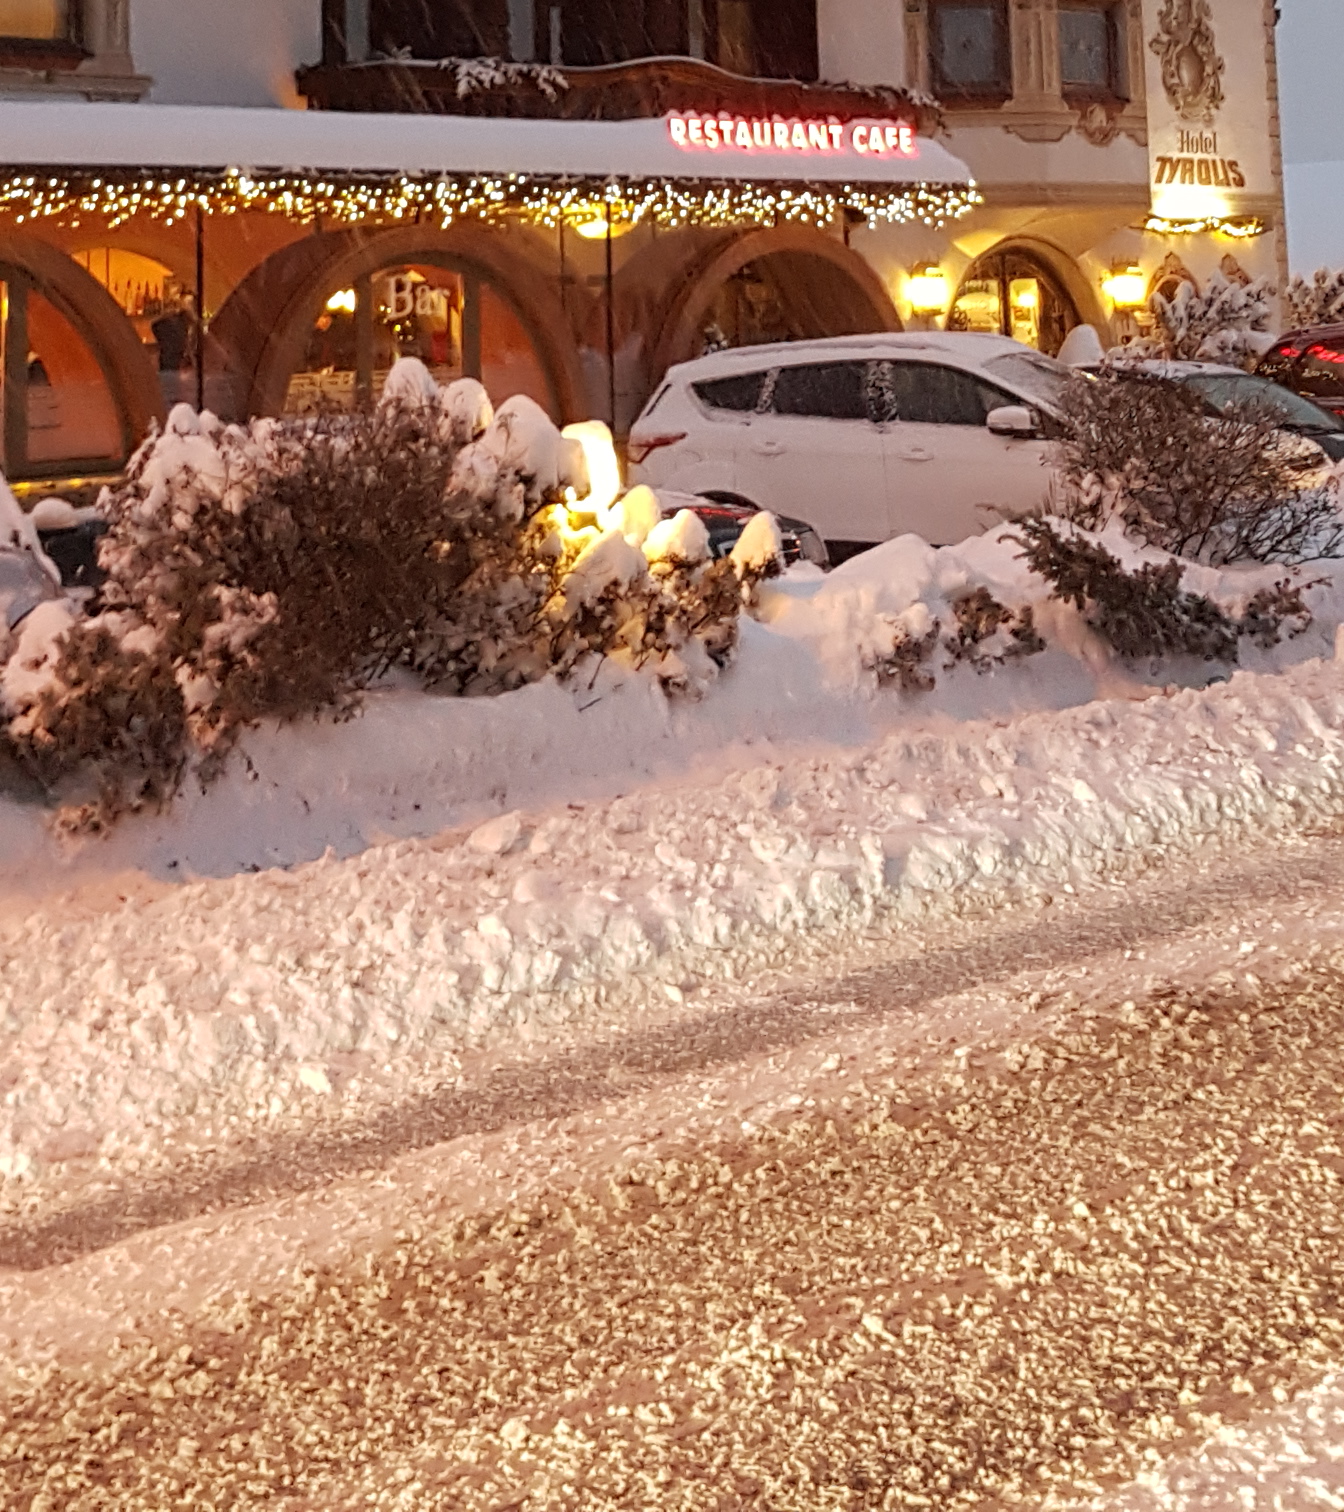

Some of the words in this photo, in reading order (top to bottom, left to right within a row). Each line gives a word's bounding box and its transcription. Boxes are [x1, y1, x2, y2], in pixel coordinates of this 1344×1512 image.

[669, 117, 843, 150] RESTAURANT
[852, 125, 913, 154] CAFE
[1179, 130, 1216, 154] Hotel
[1155, 156, 1245, 187] TYROLIS
[389, 274, 450, 320] Bar
